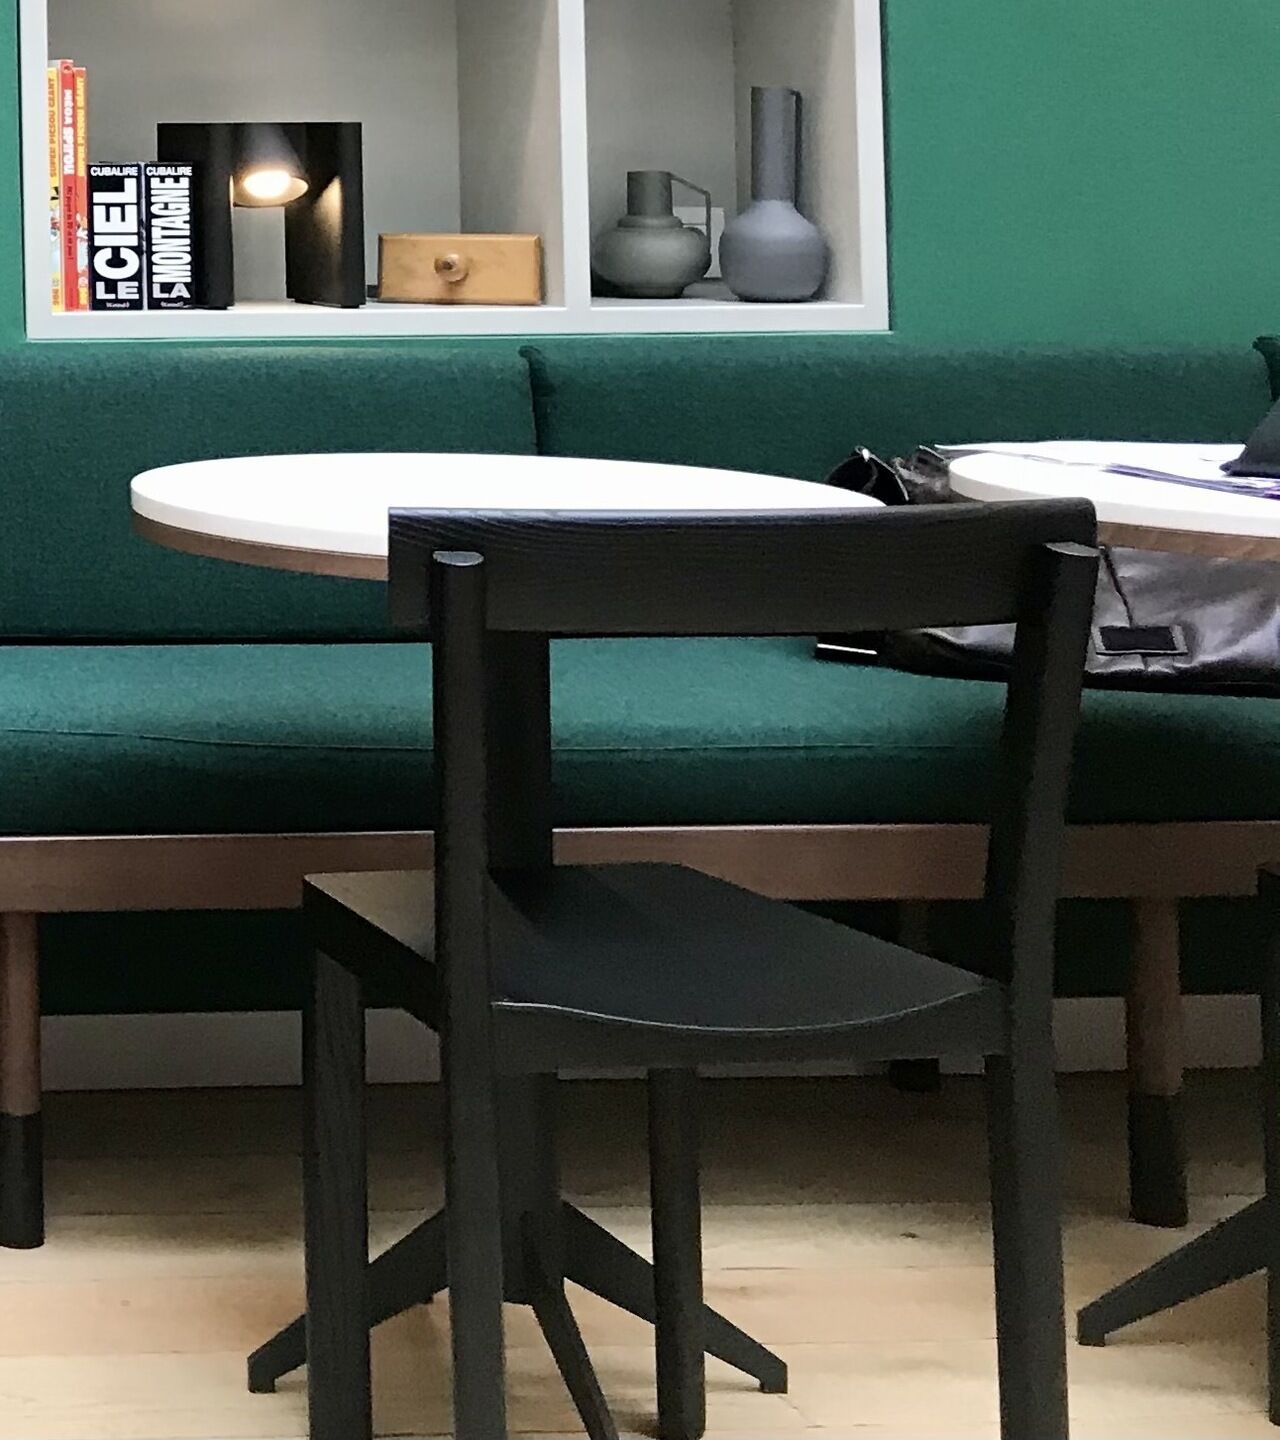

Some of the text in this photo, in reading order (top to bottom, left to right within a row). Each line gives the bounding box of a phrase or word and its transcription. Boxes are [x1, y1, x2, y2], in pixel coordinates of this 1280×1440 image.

[48, 111, 57, 145] PICSOU
[63, 126, 75, 175] SPIROU
[91, 166, 139, 177] CUBALIRE
[146, 166, 193, 177] CUBALIRE
[93, 177, 140, 280] CIEL
[150, 177, 193, 283] MONTAGNE
[96, 281, 140, 300] LE
[152, 282, 191, 298] LA
